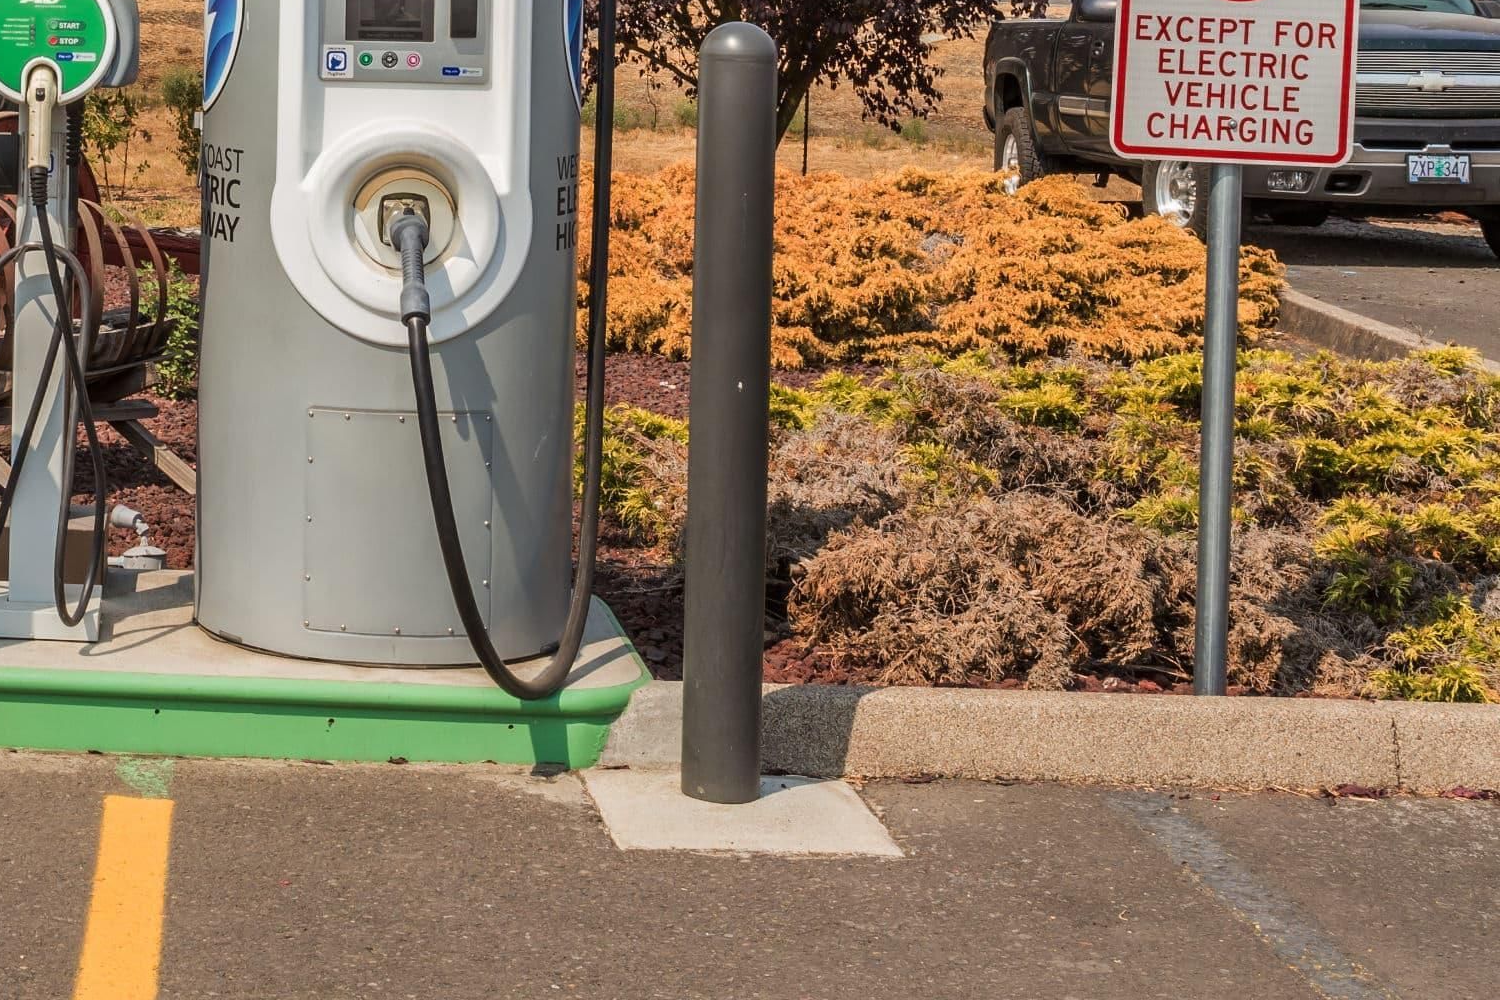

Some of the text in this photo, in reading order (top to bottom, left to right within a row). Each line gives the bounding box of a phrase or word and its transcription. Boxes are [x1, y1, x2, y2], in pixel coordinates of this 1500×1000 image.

[58, 22, 81, 30] START
[59, 37, 79, 45] STOP
[1135, 14, 1337, 49] EXCEPT FOR
[1158, 48, 1310, 81] ELECTRIC
[1164, 80, 1301, 113] VEHICLE
[1146, 112, 1314, 146] CHARGING
[1411, 160, 1467, 177] ZXP 347
